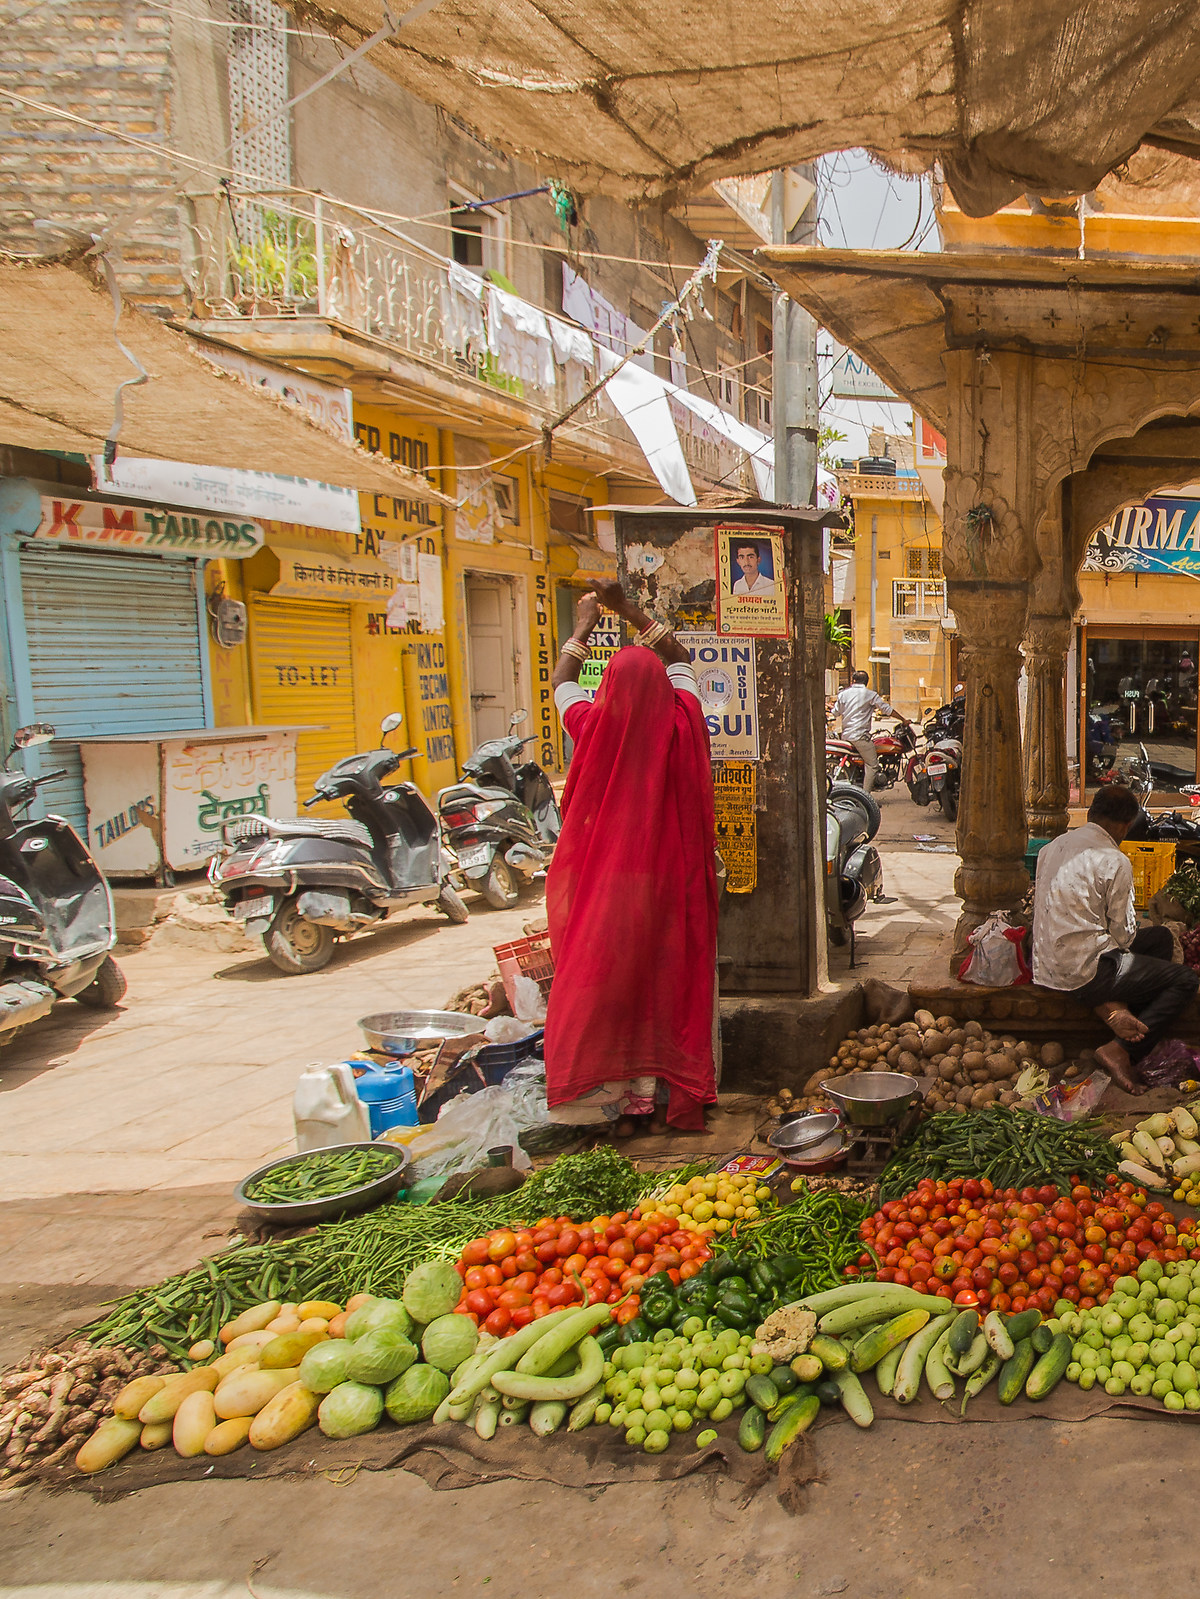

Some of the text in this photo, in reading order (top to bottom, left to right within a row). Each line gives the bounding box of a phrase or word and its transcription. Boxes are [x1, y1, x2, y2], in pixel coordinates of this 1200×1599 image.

[144, 512, 258, 550] TAILORS
[688, 647, 750, 663] JOIN
[274, 665, 339, 686] TO-LET
[736, 665, 748, 711] NSUI
